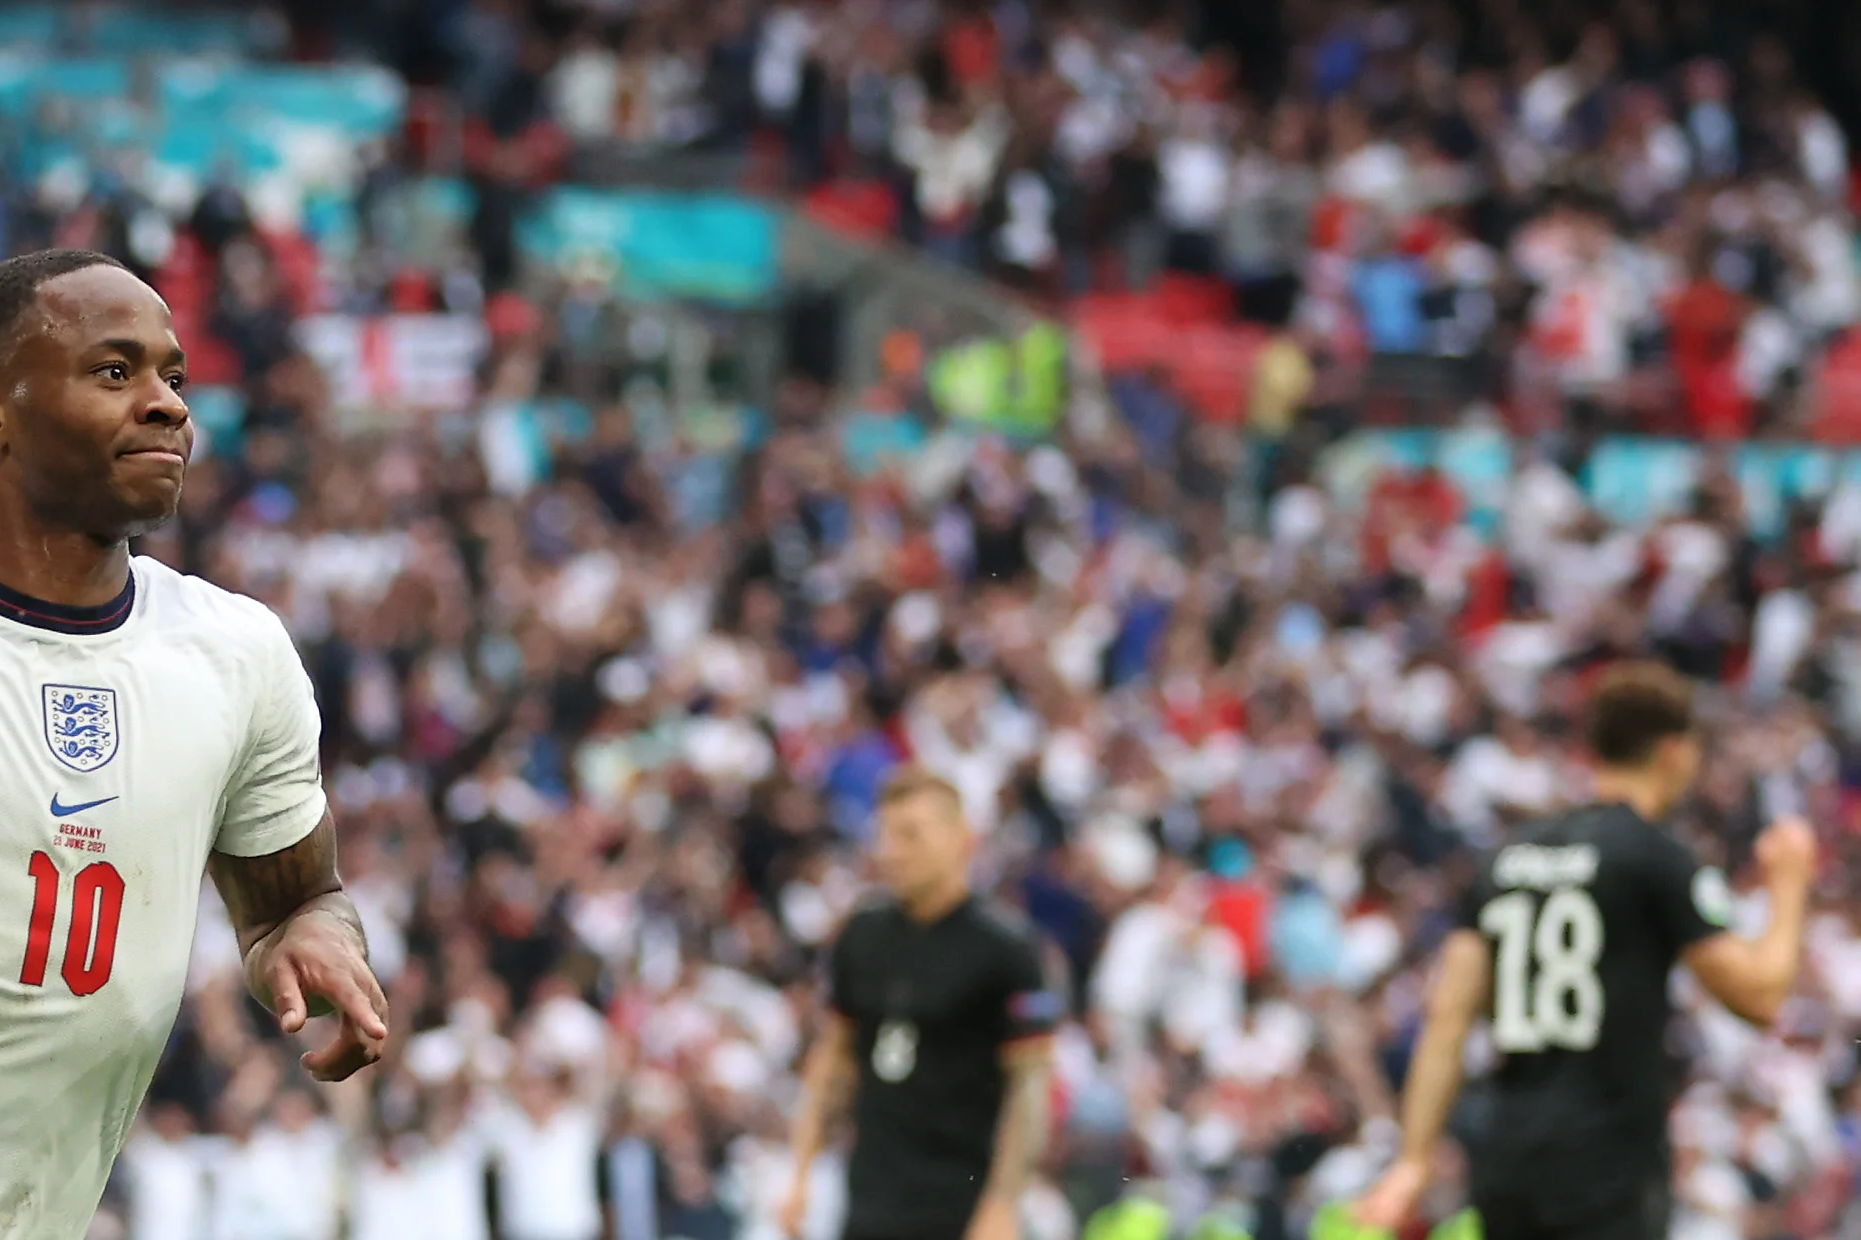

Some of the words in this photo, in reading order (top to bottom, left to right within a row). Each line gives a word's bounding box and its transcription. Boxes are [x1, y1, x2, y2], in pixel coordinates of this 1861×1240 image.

[59, 824, 102, 839] GERMANY
[64, 838, 85, 850] JUNE
[20, 850, 125, 996] 10
[1478, 888, 1606, 1052] 18
